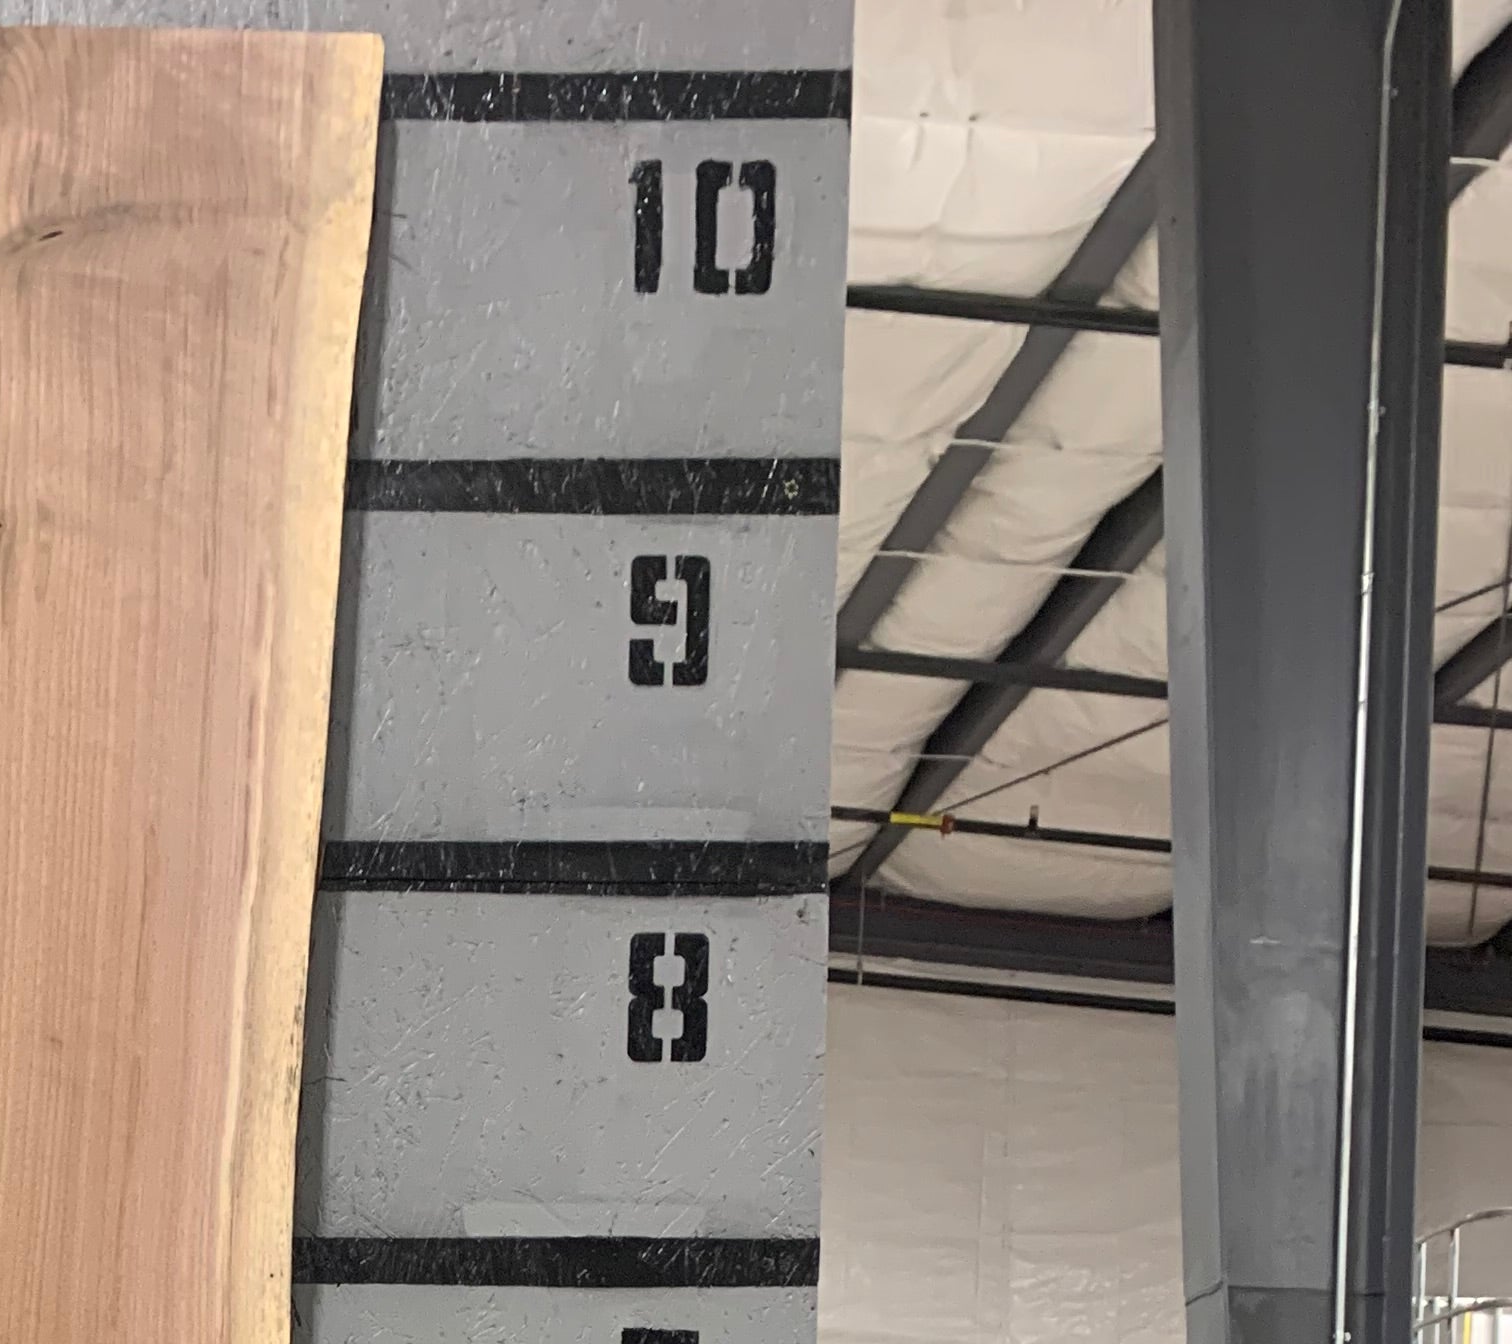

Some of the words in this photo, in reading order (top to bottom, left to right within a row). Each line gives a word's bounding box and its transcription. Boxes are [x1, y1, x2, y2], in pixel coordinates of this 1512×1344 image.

[629, 161, 775, 294] 10
[629, 556, 710, 686] 9
[628, 933, 709, 1062] 8
